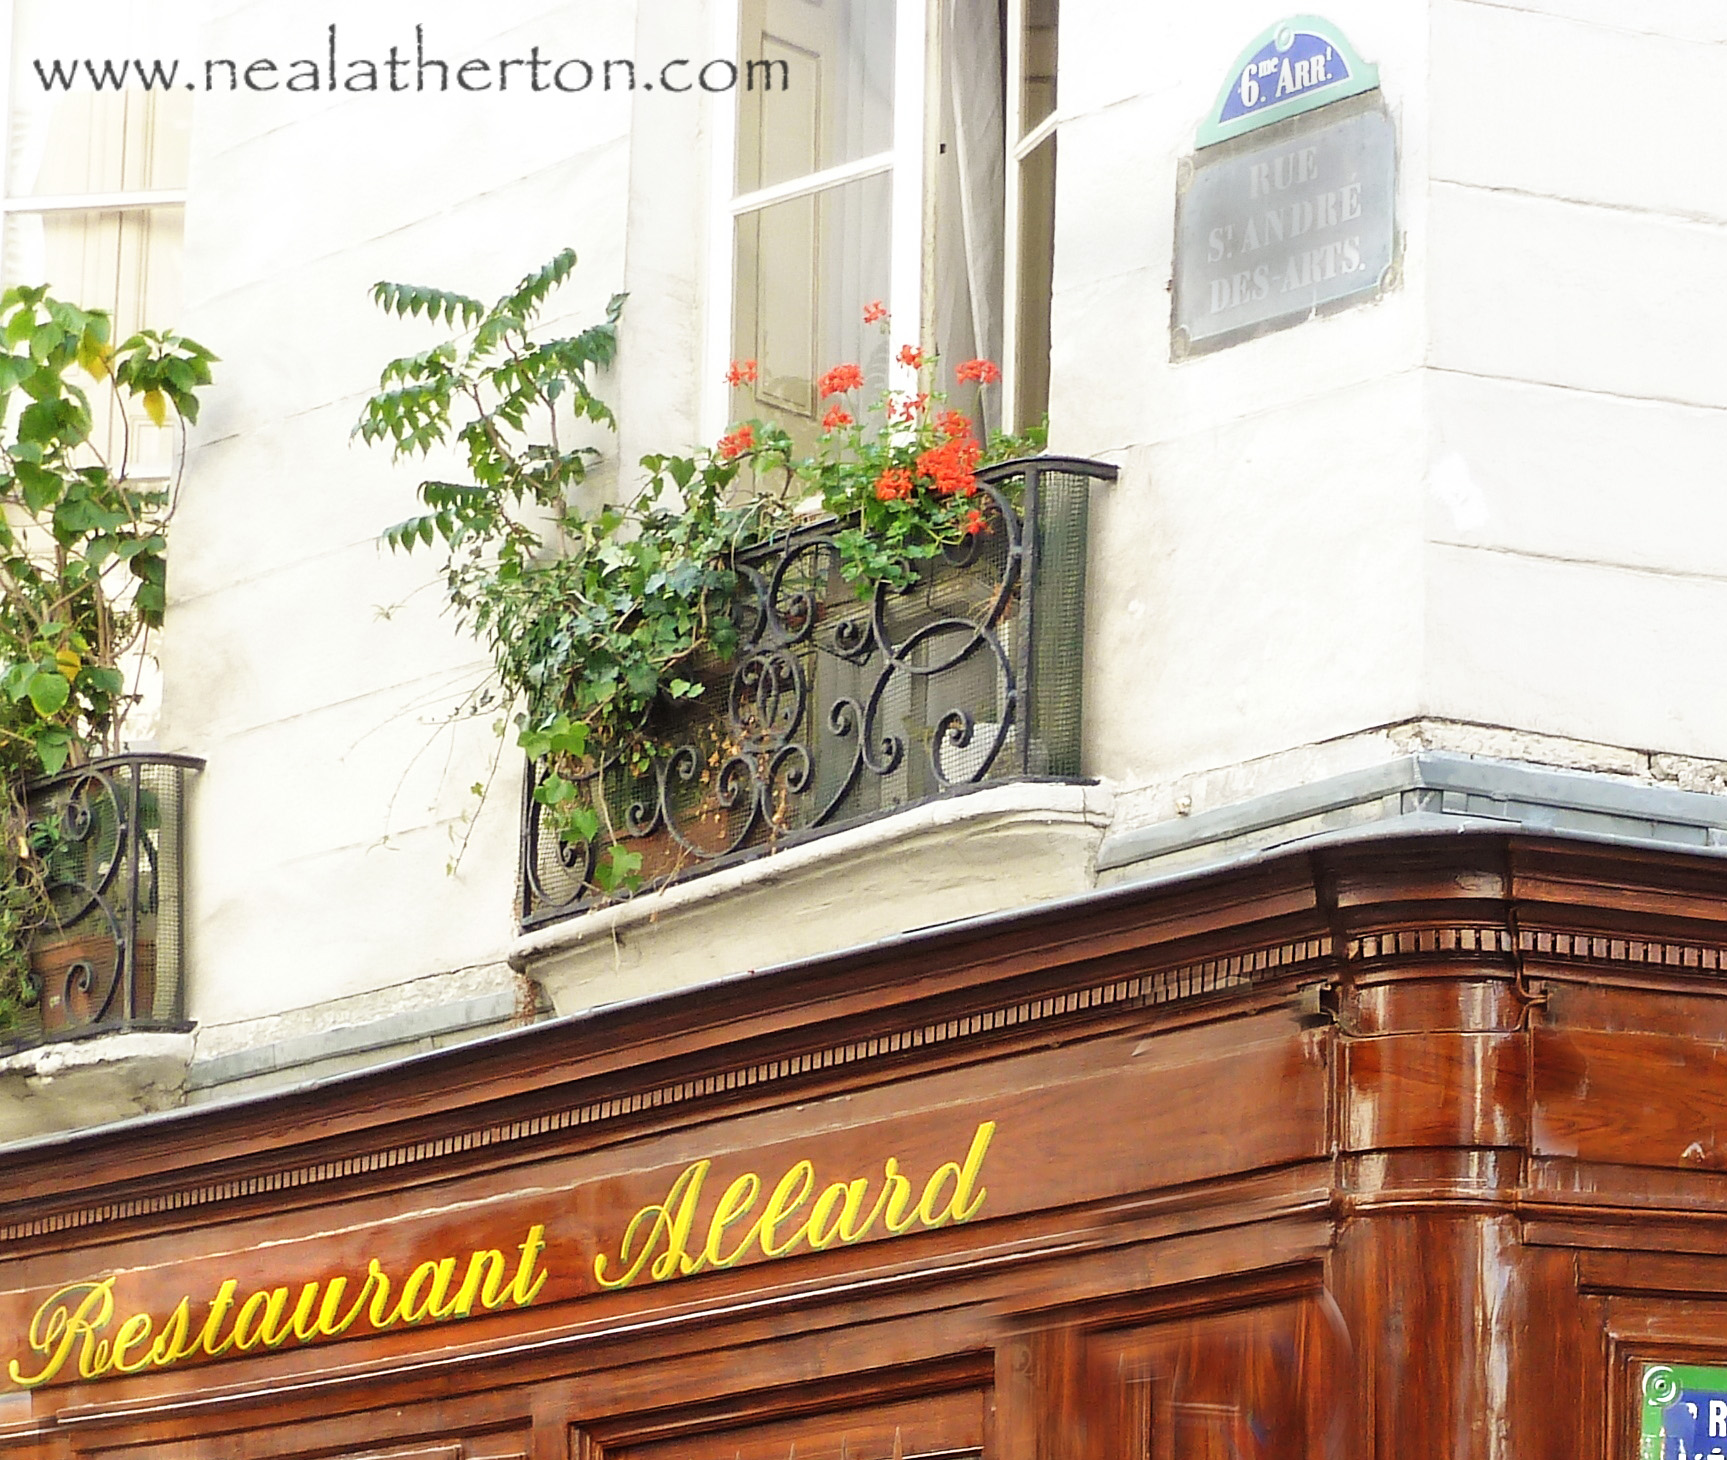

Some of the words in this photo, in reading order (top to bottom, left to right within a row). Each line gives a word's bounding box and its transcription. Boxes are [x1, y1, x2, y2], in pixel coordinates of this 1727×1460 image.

[1249, 146, 1318, 199] RUE
[9, 1223, 549, 1386] Restaurant
[594, 1121, 997, 1289] Allard
